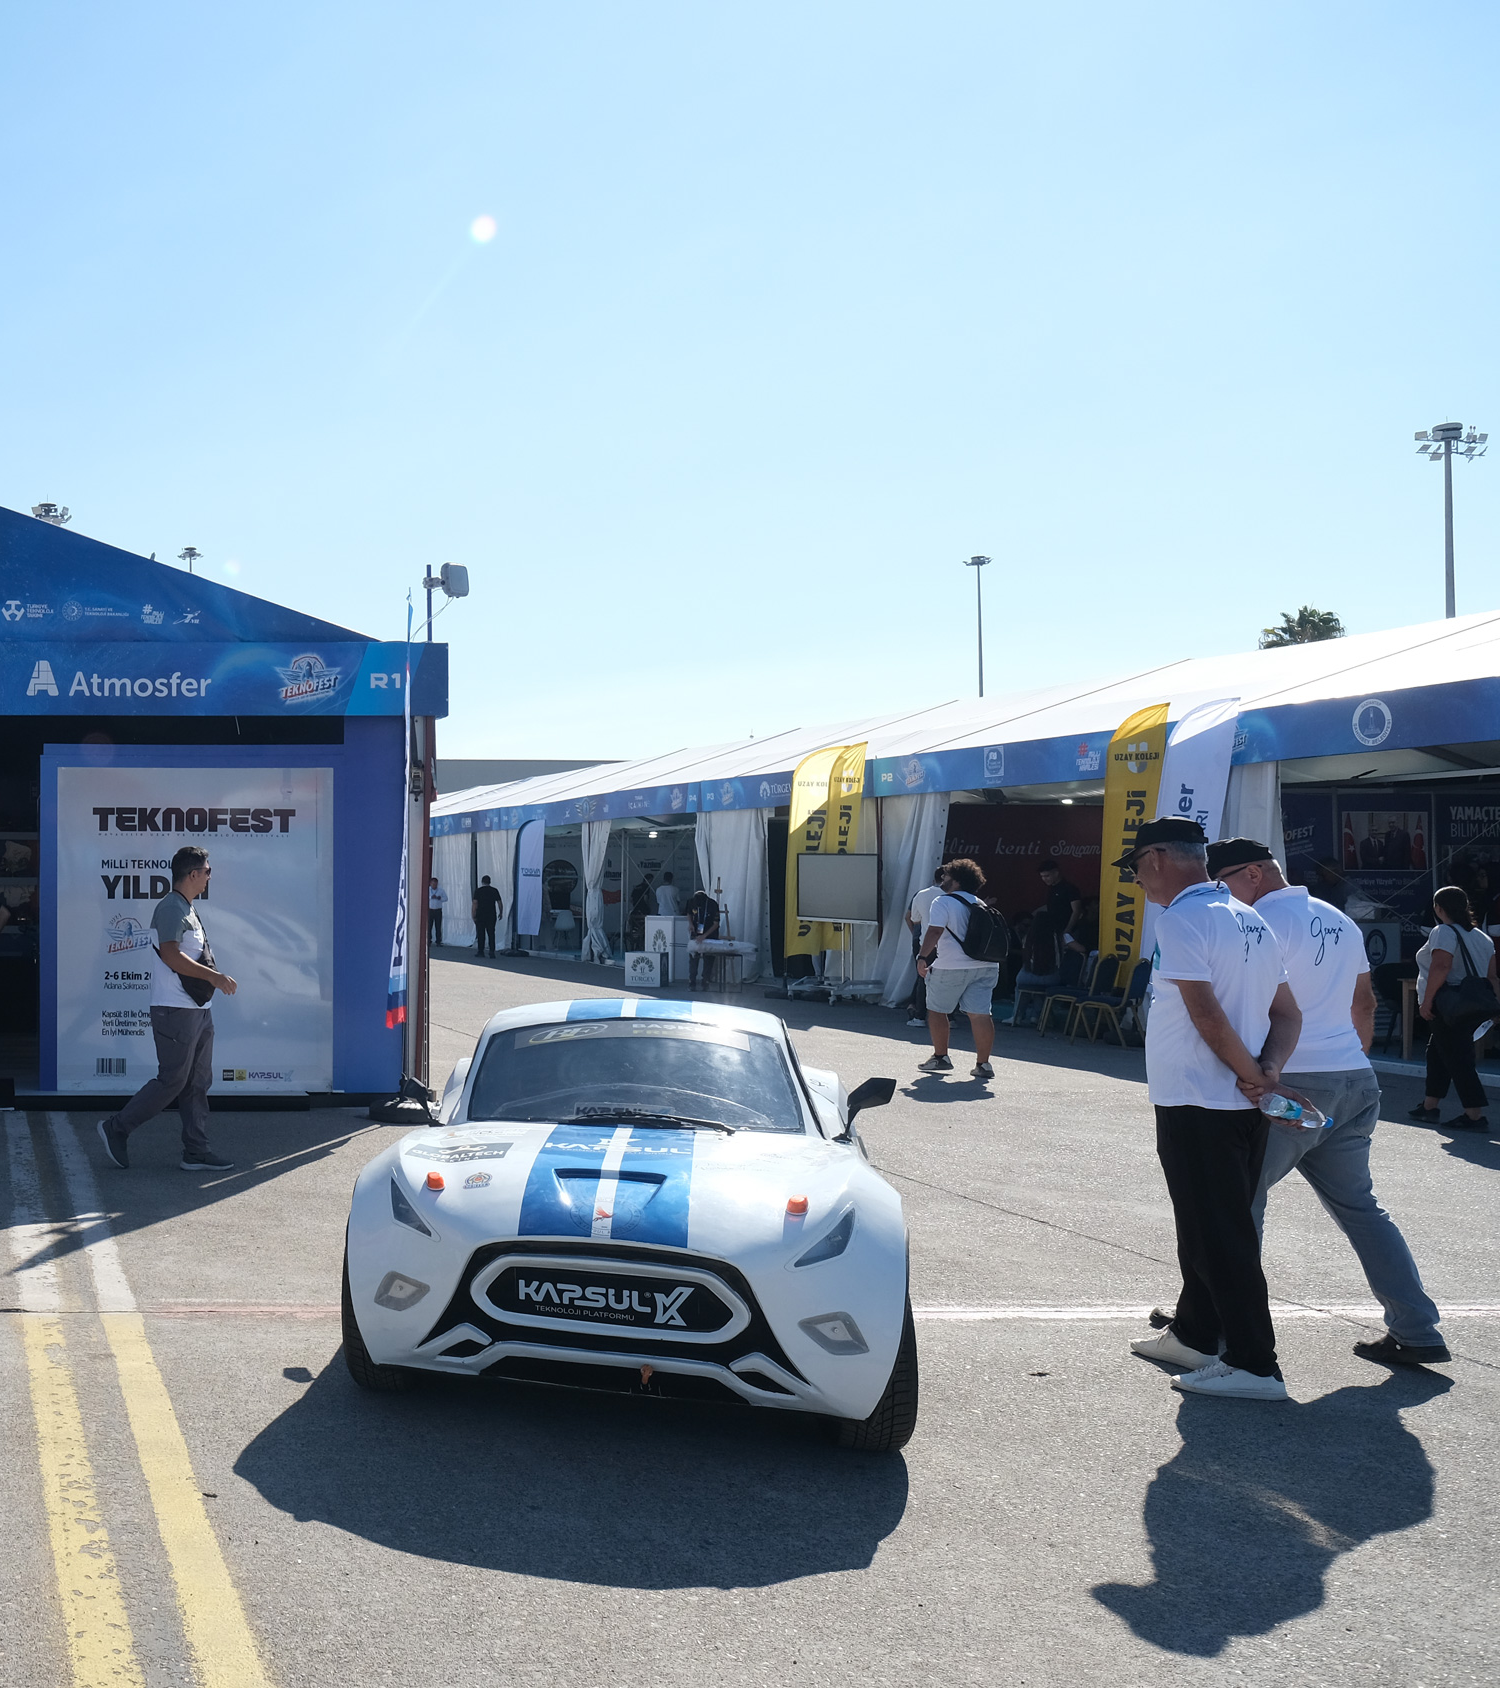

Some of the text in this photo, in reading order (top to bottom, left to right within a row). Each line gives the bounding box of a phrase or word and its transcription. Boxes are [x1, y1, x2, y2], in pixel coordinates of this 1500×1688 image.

[69, 671, 211, 697] Atmosfer
[281, 676, 339, 699] TEKNOFEST
[370, 673, 400, 688] R1
[1114, 753, 1133, 761] UZAY
[882, 773, 893, 782] P2
[92, 807, 296, 833] TEKNOFEST
[1284, 825, 1315, 841] OFEST
[945, 838, 980, 855] ilim
[995, 837, 1042, 855] kenti
[131, 859, 173, 869] TEKNOL
[1115, 893, 1135, 962] UZAY
[104, 971, 119, 980] 2-6
[121, 971, 142, 980] Ekim
[411, 1149, 505, 1160] GLOBALTECH
[518, 1279, 651, 1313] KAPSUL
[583, 1309, 635, 1322] PLATFORMU
